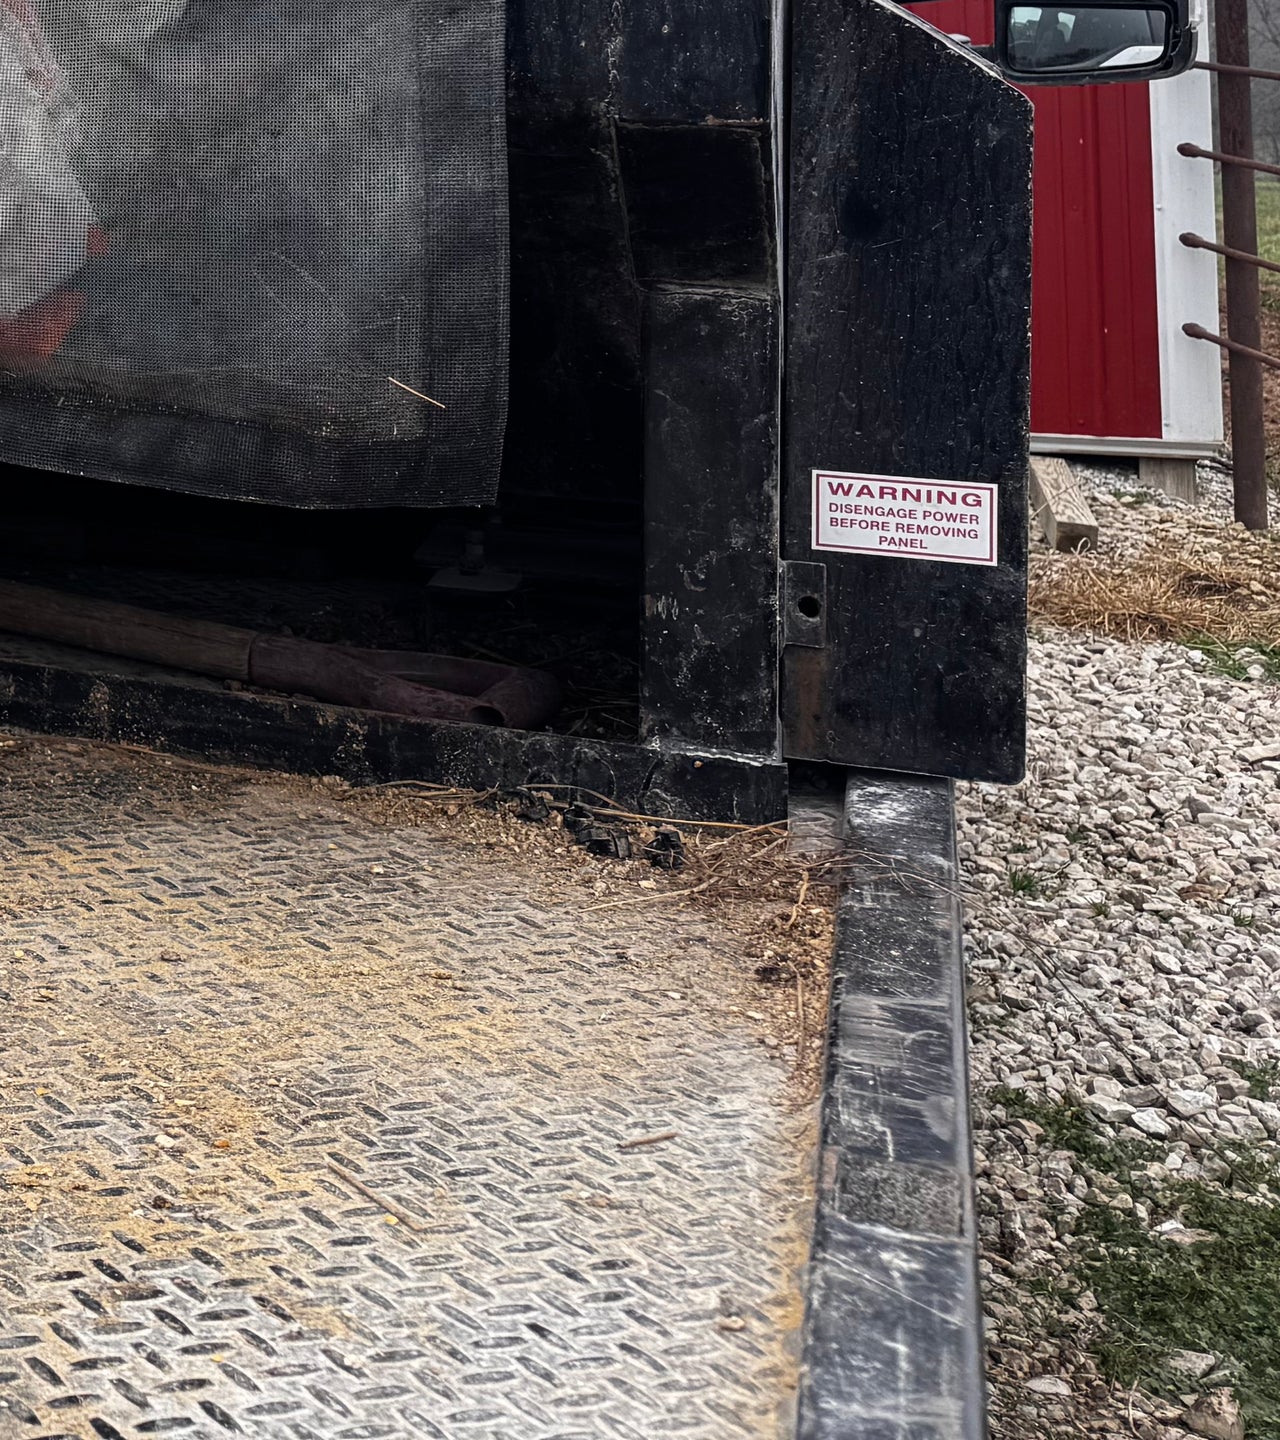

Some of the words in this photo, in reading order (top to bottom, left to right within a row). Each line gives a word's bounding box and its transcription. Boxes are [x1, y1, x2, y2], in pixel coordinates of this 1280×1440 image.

[826, 481, 983, 508] WARNING
[828, 502, 918, 520] DISENGAGE
[922, 510, 980, 525] POWER
[829, 517, 891, 532] BEFORE
[895, 522, 979, 540] REMOVING
[878, 535, 928, 550] PANEL
